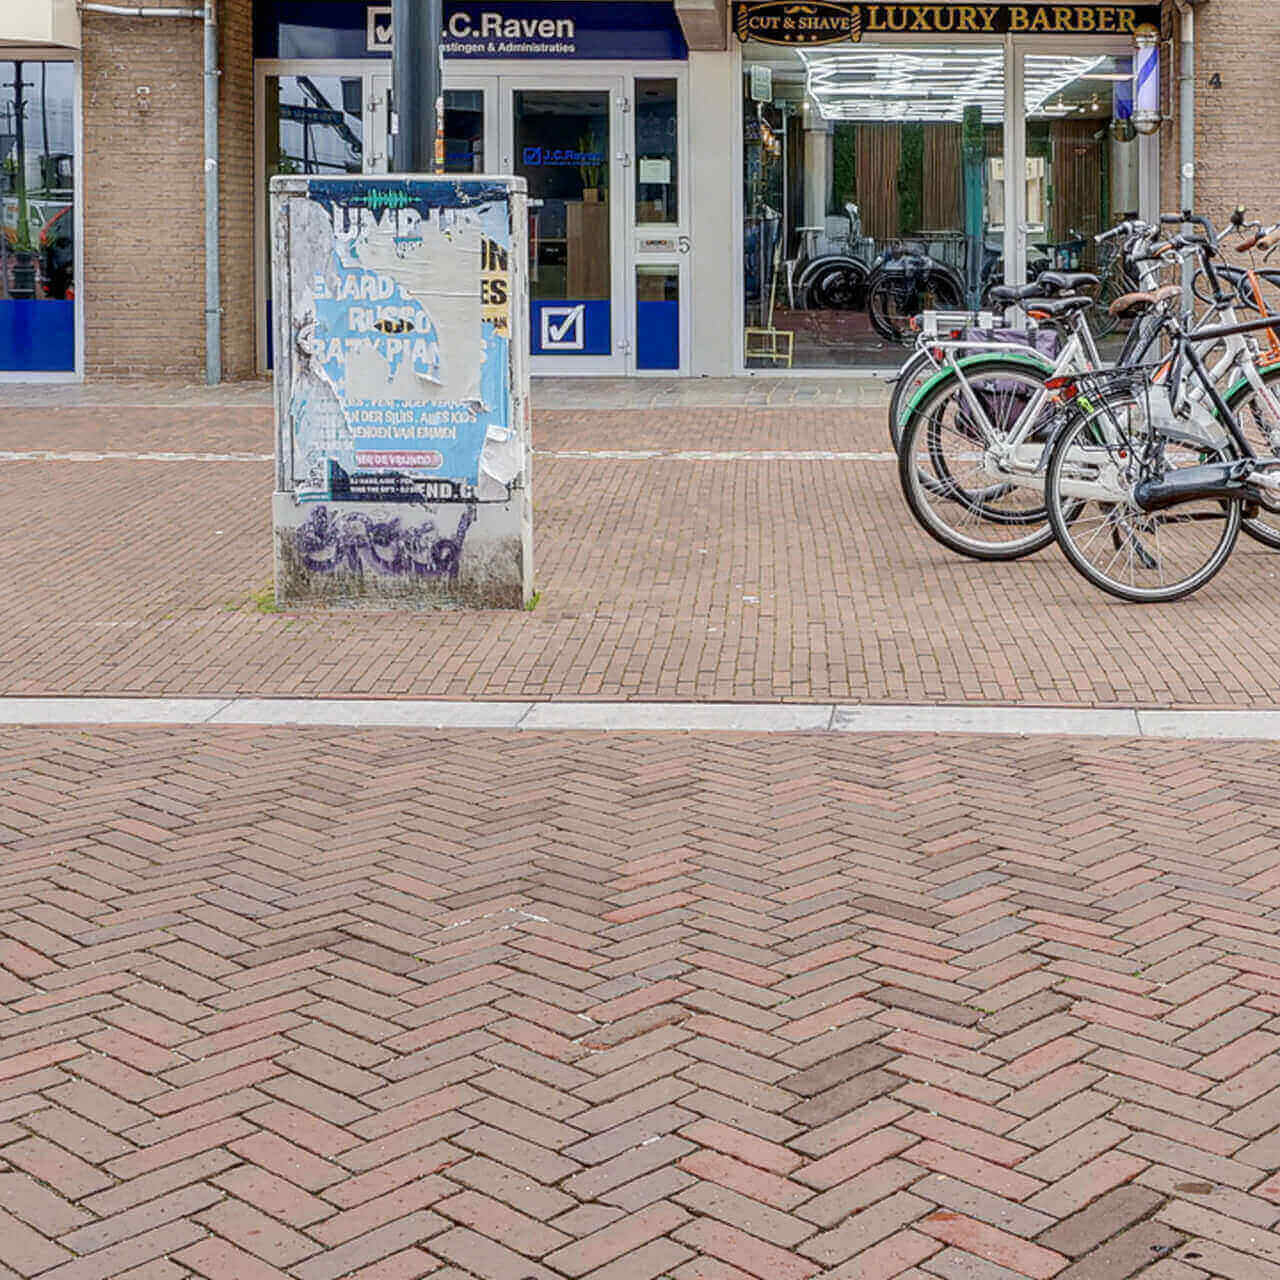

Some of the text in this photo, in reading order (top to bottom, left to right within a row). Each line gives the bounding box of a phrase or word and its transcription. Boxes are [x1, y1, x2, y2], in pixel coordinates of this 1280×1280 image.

[442, 12, 575, 38] .C.Raven
[749, 16, 850, 30] CUT & SHAVE
[866, 6, 1137, 32] LUXURY BARBER
[1209, 72, 1221, 89] 4
[678, 235, 690, 254] 5
